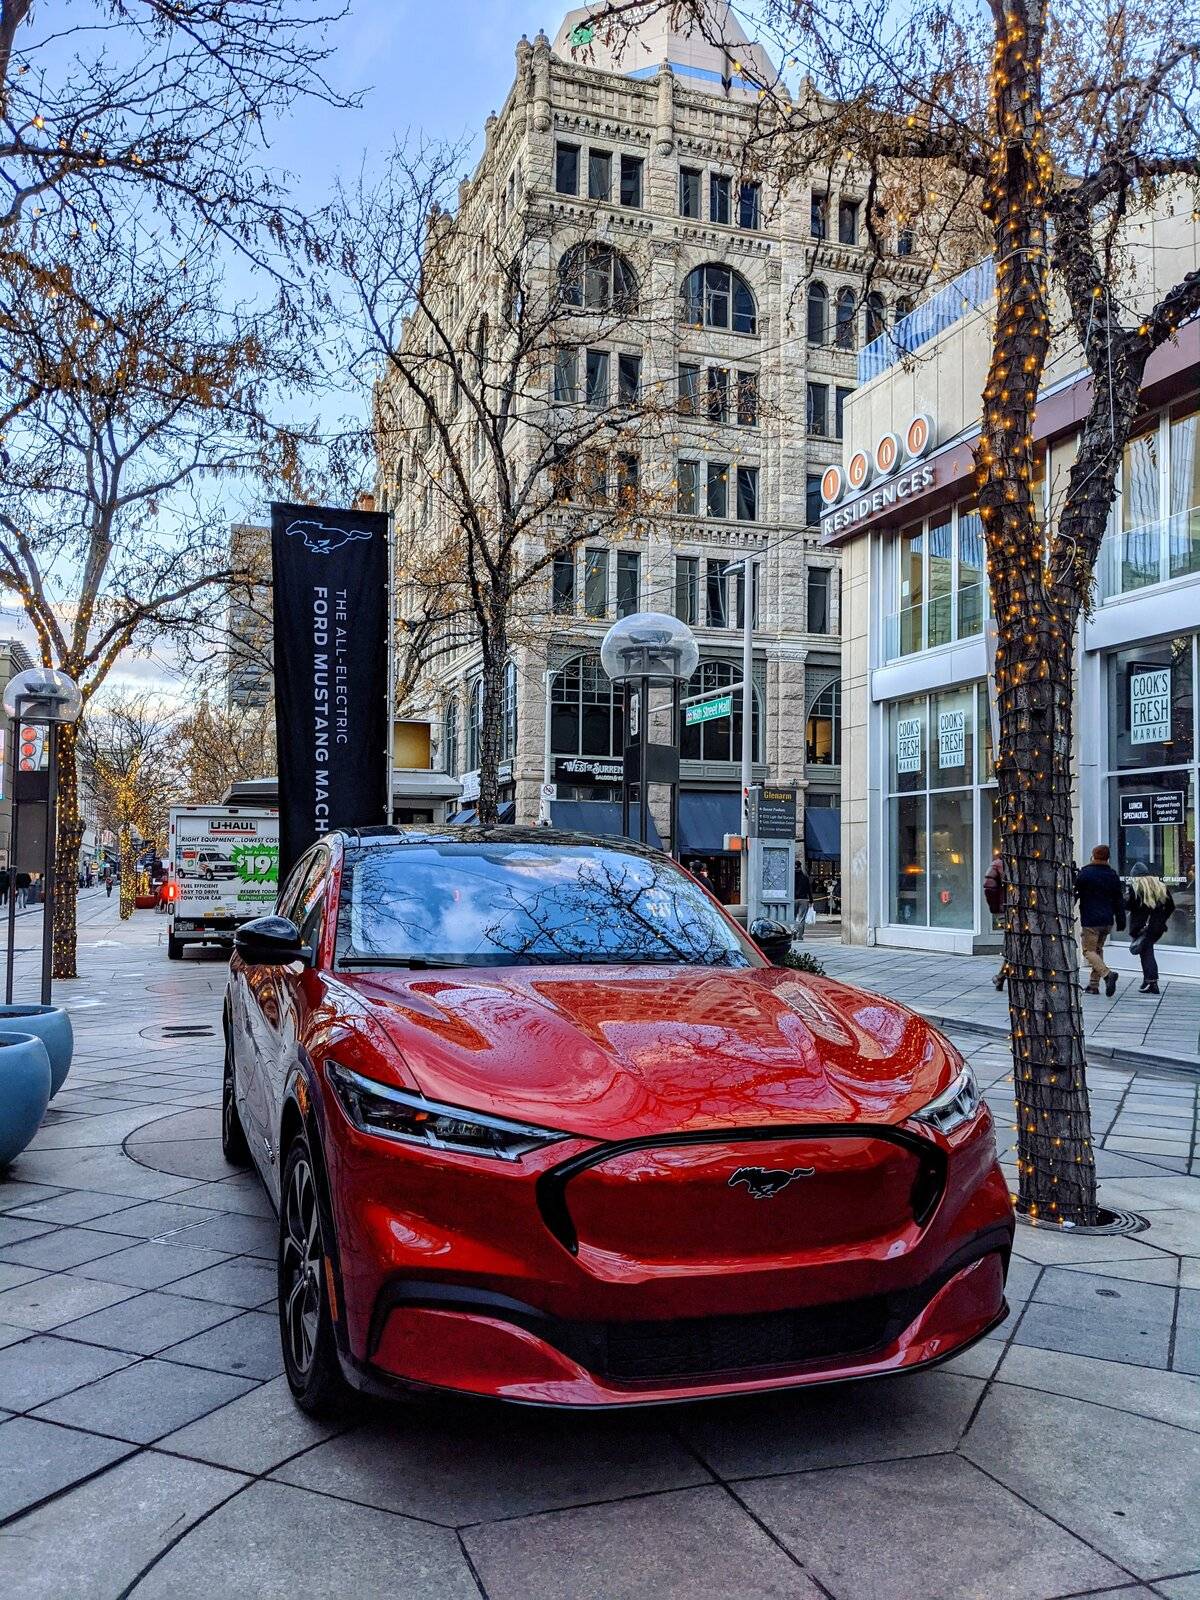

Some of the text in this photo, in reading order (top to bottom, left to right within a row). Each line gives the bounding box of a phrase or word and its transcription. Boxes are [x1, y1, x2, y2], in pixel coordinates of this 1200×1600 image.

[829, 427, 922, 495] 1600
[824, 465, 934, 535] RESIDENCES
[313, 586, 328, 646] FORD
[335, 589, 348, 744] THE ALL-ELECTRIC
[1133, 673, 1168, 697] COOK'S
[314, 653, 329, 762] MUSTANG
[702, 703, 719, 718] Street
[1133, 698, 1169, 724] FRESH
[898, 720, 920, 738] COOK'S
[941, 711, 963, 731] COOK'S
[1133, 725, 1168, 740] MARKET
[899, 739, 920, 758] FRESH
[941, 732, 964, 753] FRESH
[592, 762, 624, 775] SURREN
[899, 759, 920, 770] MARKET
[941, 753, 964, 766] MARKET
[763, 790, 792, 800] Glenarm
[1128, 801, 1143, 810] LUNCH
[1123, 811, 1149, 820] SPECIALTIES
[210, 821, 256, 830] U-HAUL
